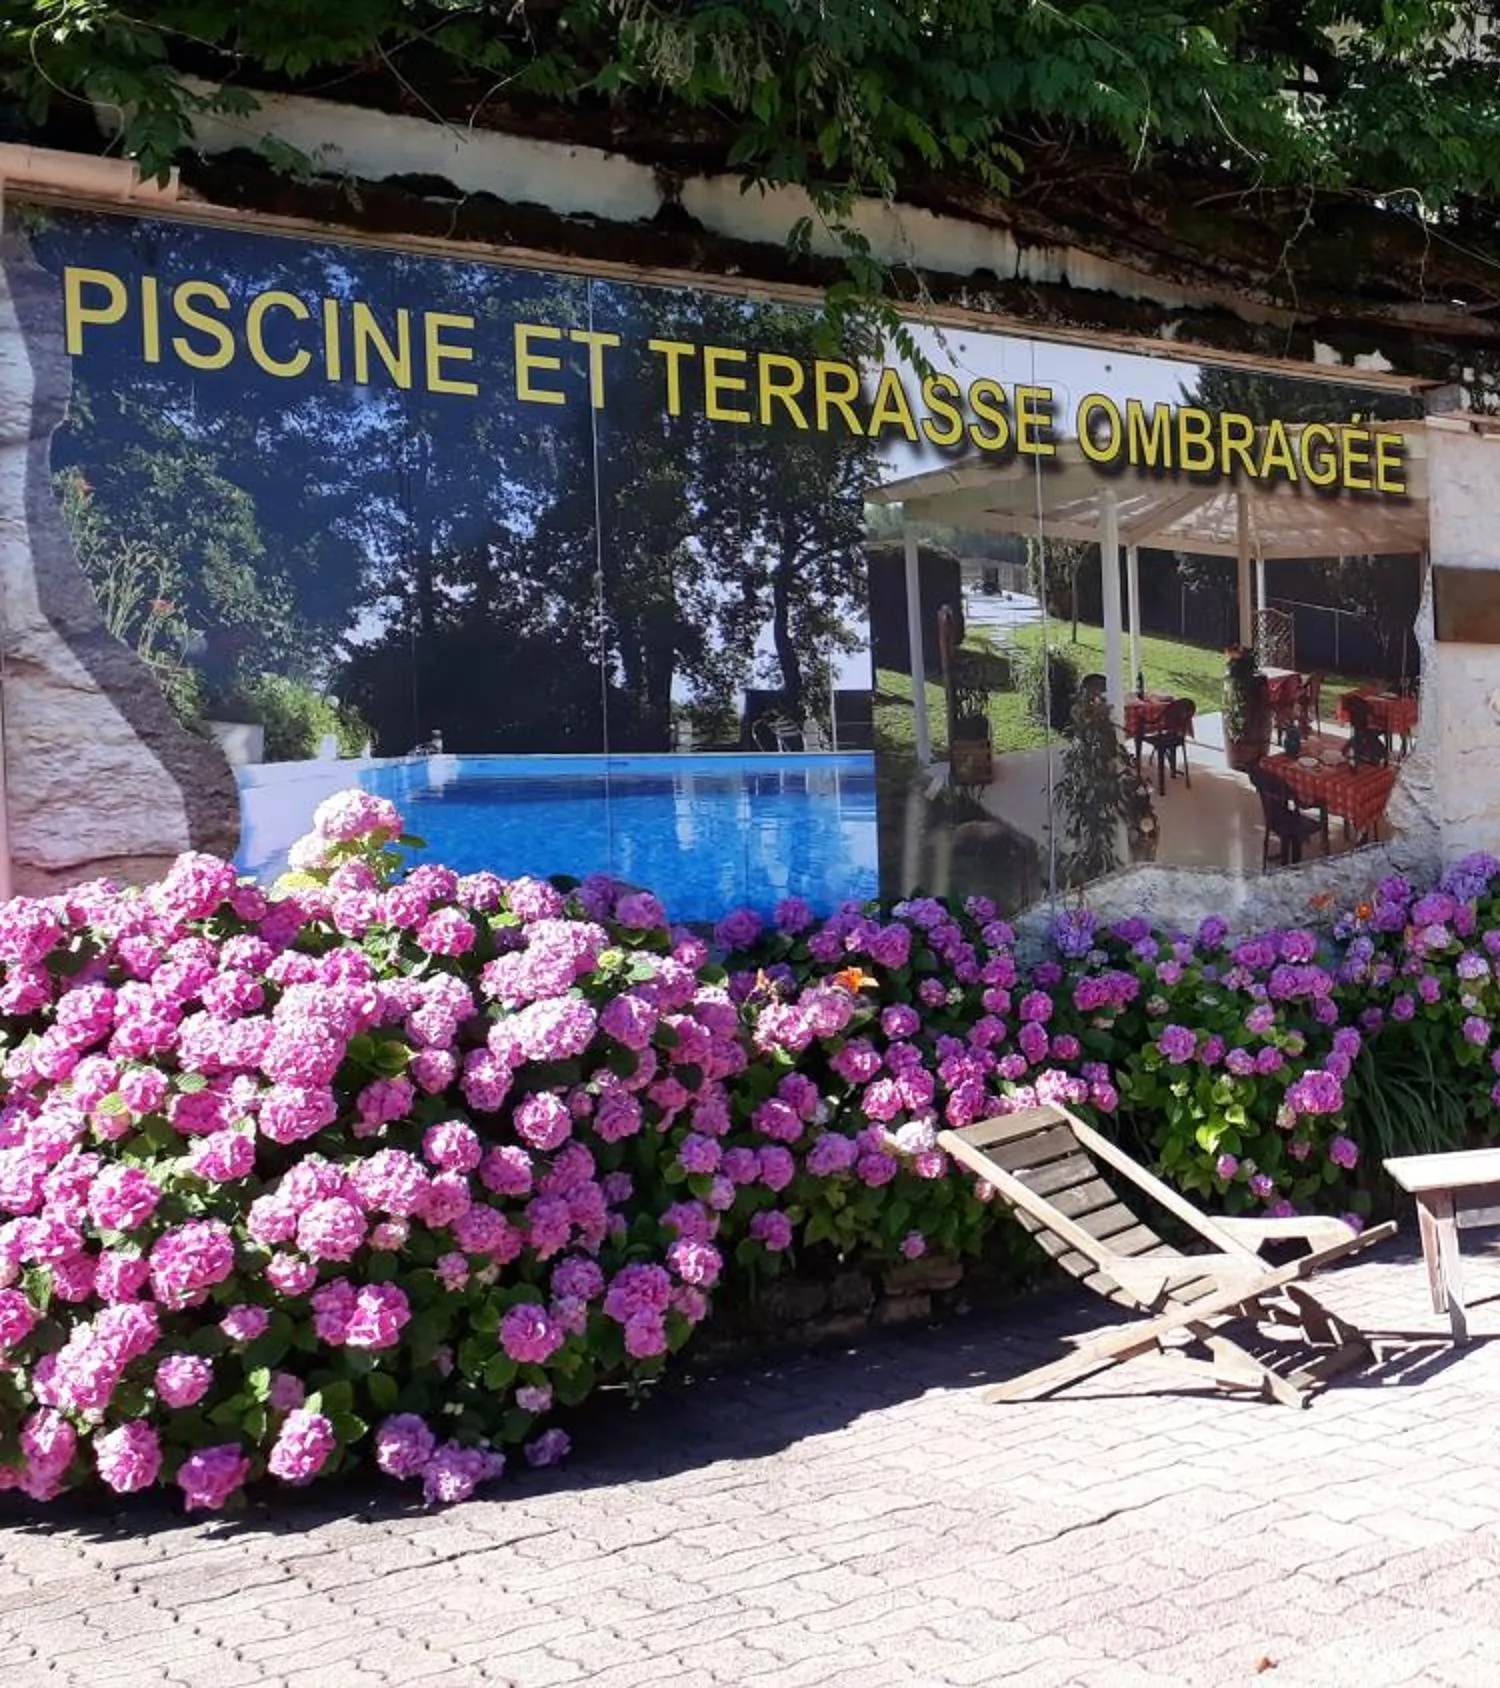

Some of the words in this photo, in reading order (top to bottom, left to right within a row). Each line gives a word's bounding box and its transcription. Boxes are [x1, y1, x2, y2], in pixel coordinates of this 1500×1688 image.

[63, 266, 479, 396] PISCINE
[512, 323, 621, 409] ET
[648, 339, 1056, 456] TERRASSE
[1076, 393, 1406, 493] OMBRAGÉE
